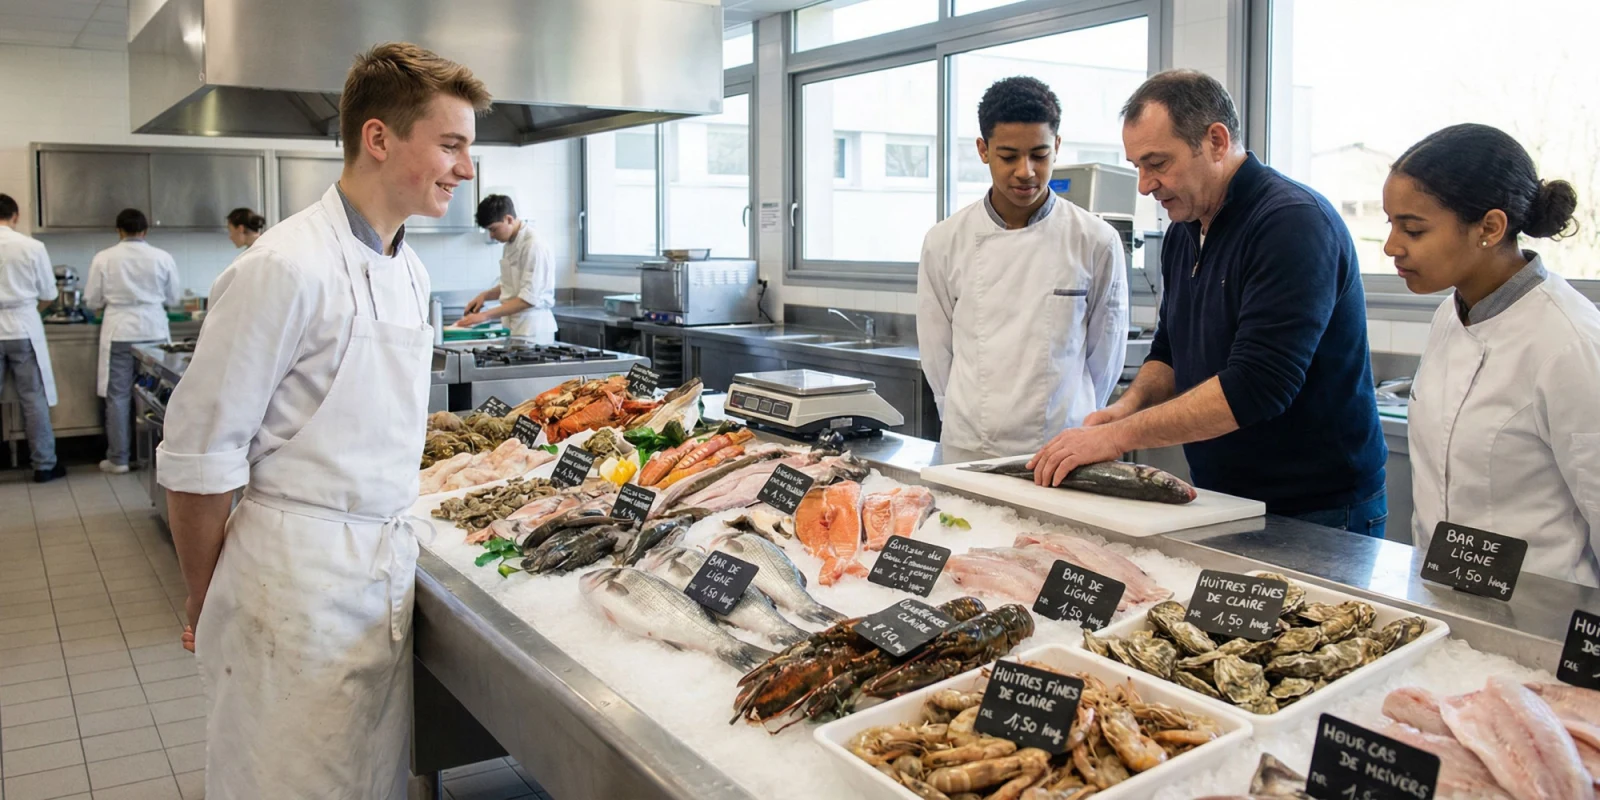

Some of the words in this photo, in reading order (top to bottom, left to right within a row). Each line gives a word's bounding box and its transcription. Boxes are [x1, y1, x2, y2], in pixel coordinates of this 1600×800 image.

[1446, 529, 1474, 547] BAR
[1482, 540, 1501, 553] DE
[708, 555, 727, 569] BAR
[728, 564, 741, 574] DE
[1451, 547, 1495, 566] LIGNE
[706, 569, 734, 587] LIGNE
[1062, 568, 1084, 585] BAR
[1088, 580, 1104, 592] DE
[1449, 567, 1481, 582] 1,50
[701, 585, 718, 599] 1,50
[1064, 585, 1098, 604] LIGNE
[1200, 576, 1246, 593] HUITRES
[1251, 583, 1284, 599] FINES
[1058, 602, 1082, 618] 1,50
[1206, 592, 1222, 603] DE
[1226, 597, 1266, 611] CLAIRE
[898, 612, 932, 633] CLAIRE
[1212, 612, 1243, 626] 1,50
[1582, 640, 1600, 656] DE
[993, 666, 1043, 691] HUITRES
[1045, 680, 1079, 700] FINES
[998, 686, 1014, 700] DE
[1016, 693, 1056, 712] CLAIRE
[1004, 712, 1037, 733] 1,50
[1339, 751, 1359, 771] DE
